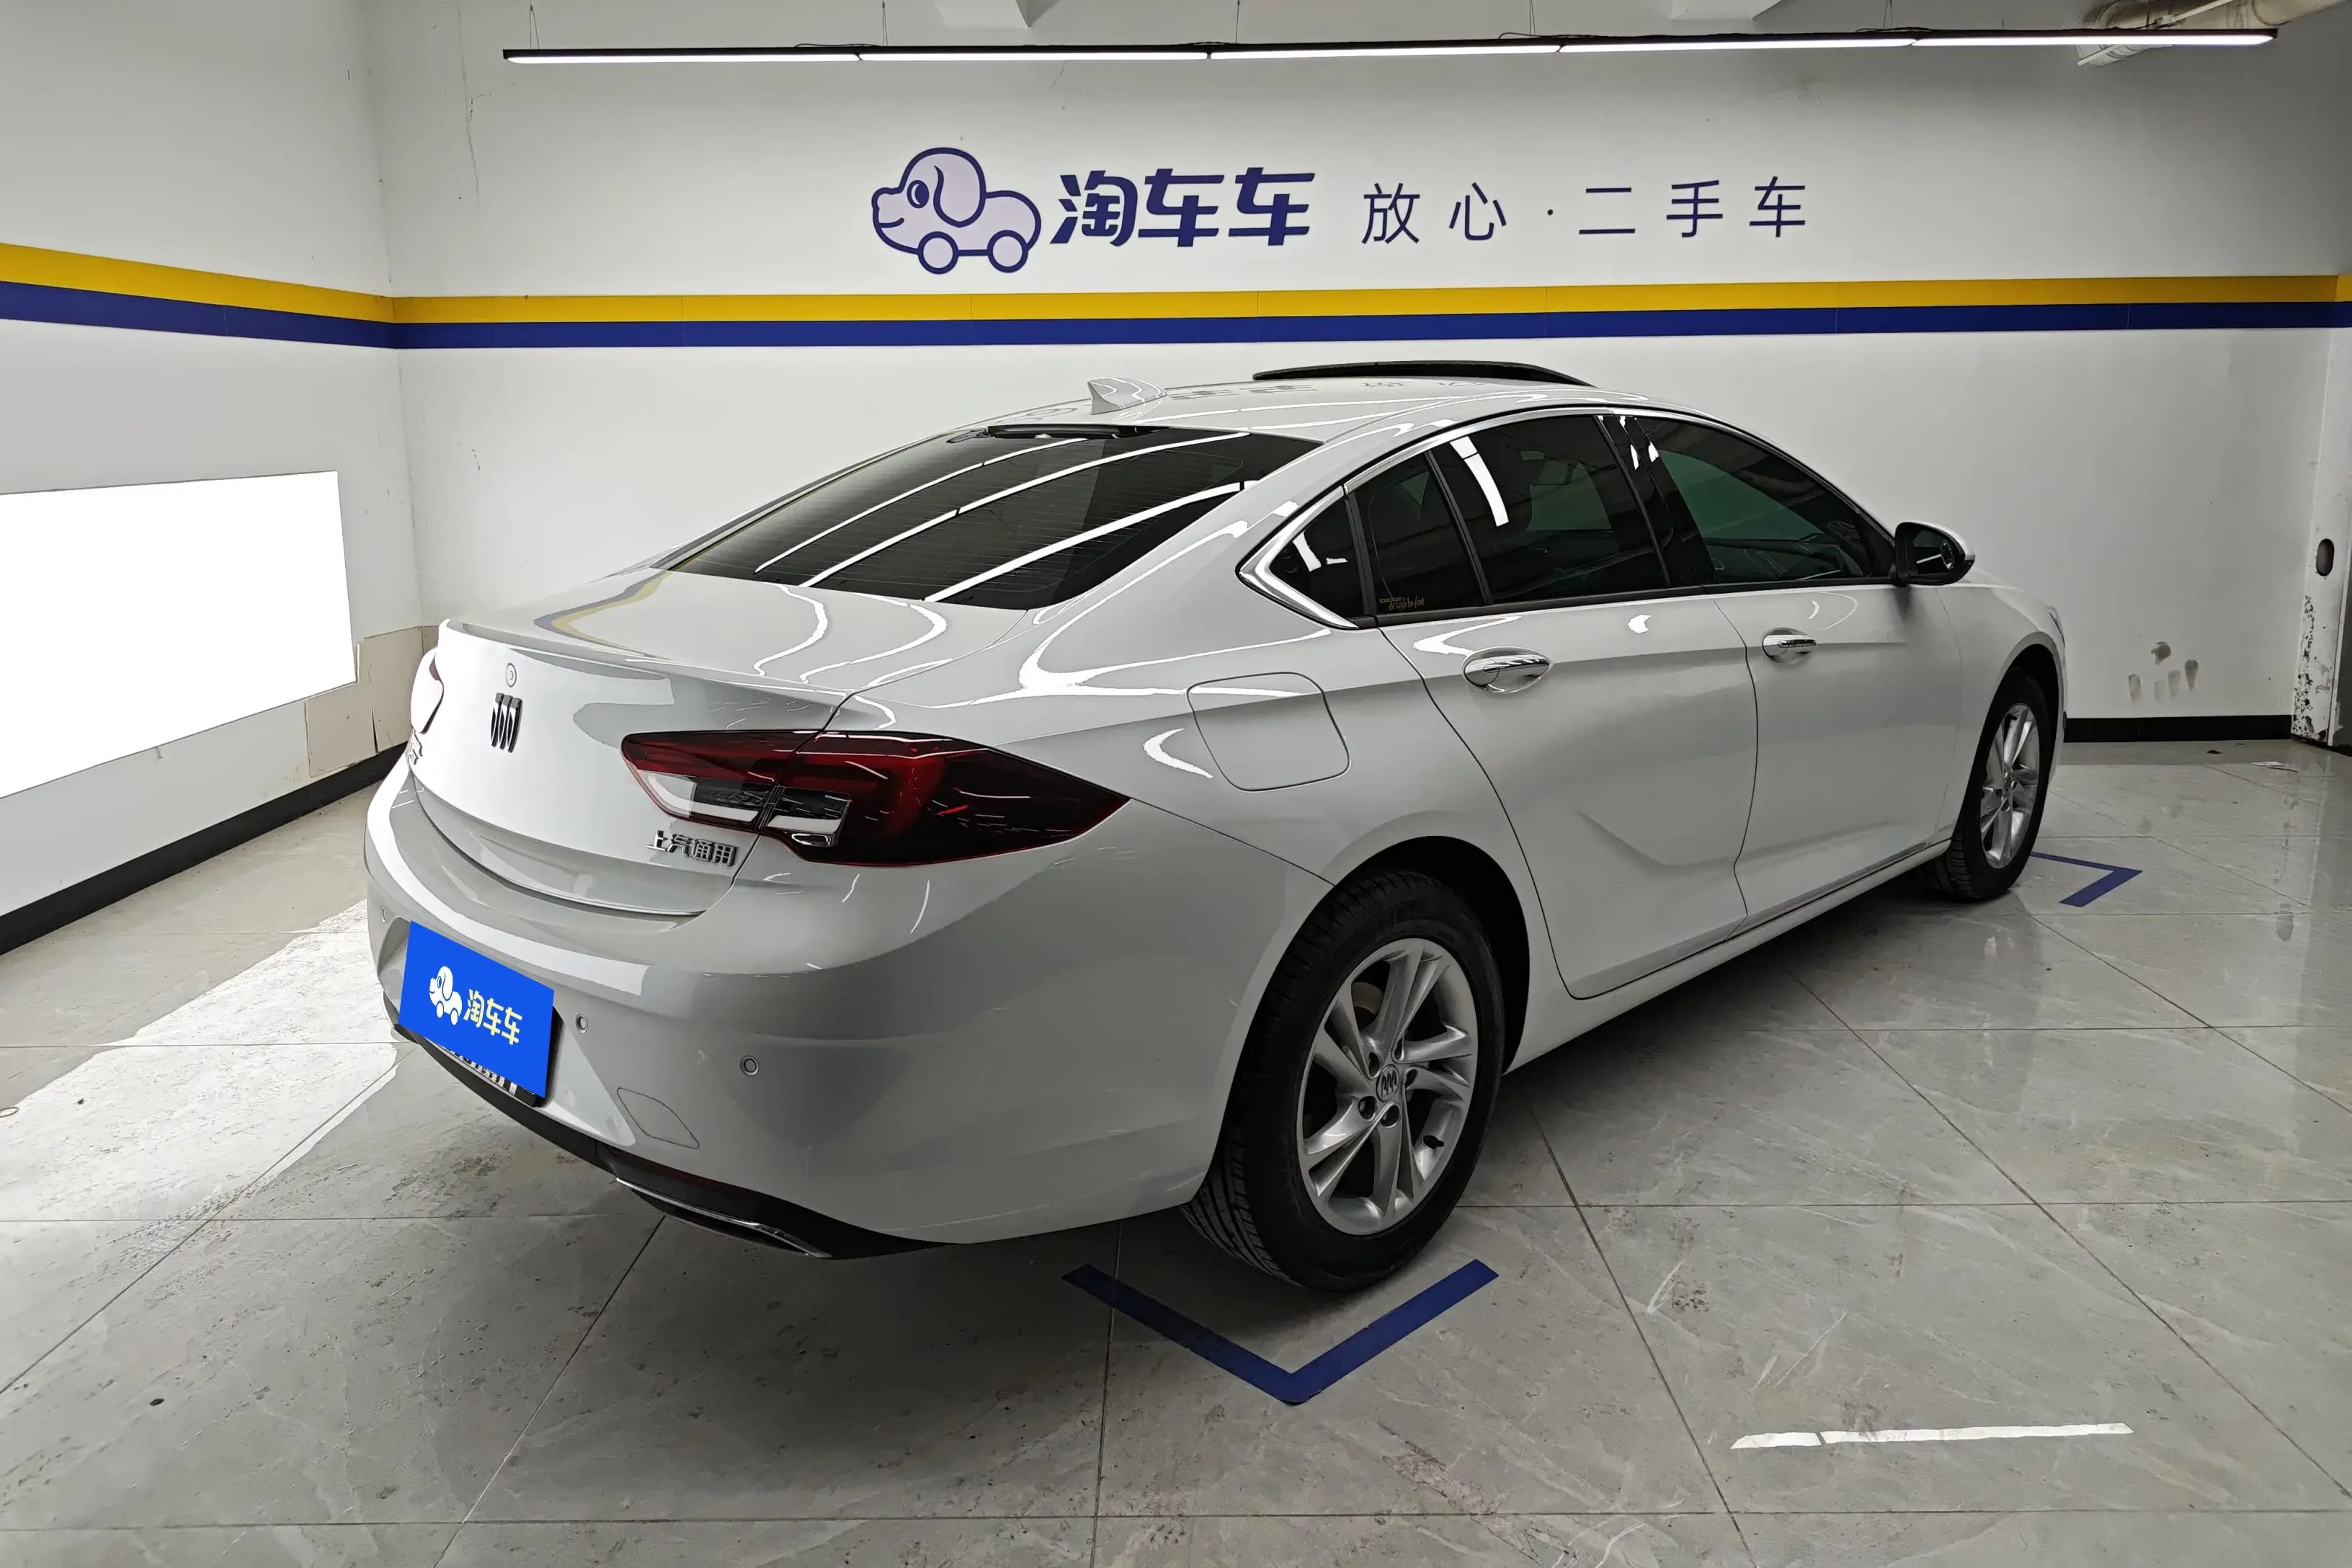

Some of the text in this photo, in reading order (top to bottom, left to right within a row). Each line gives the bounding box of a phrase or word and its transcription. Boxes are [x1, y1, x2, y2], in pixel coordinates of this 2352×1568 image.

[1050, 166, 1316, 248] 淘车车
[646, 830, 739, 866] 上汽通用
